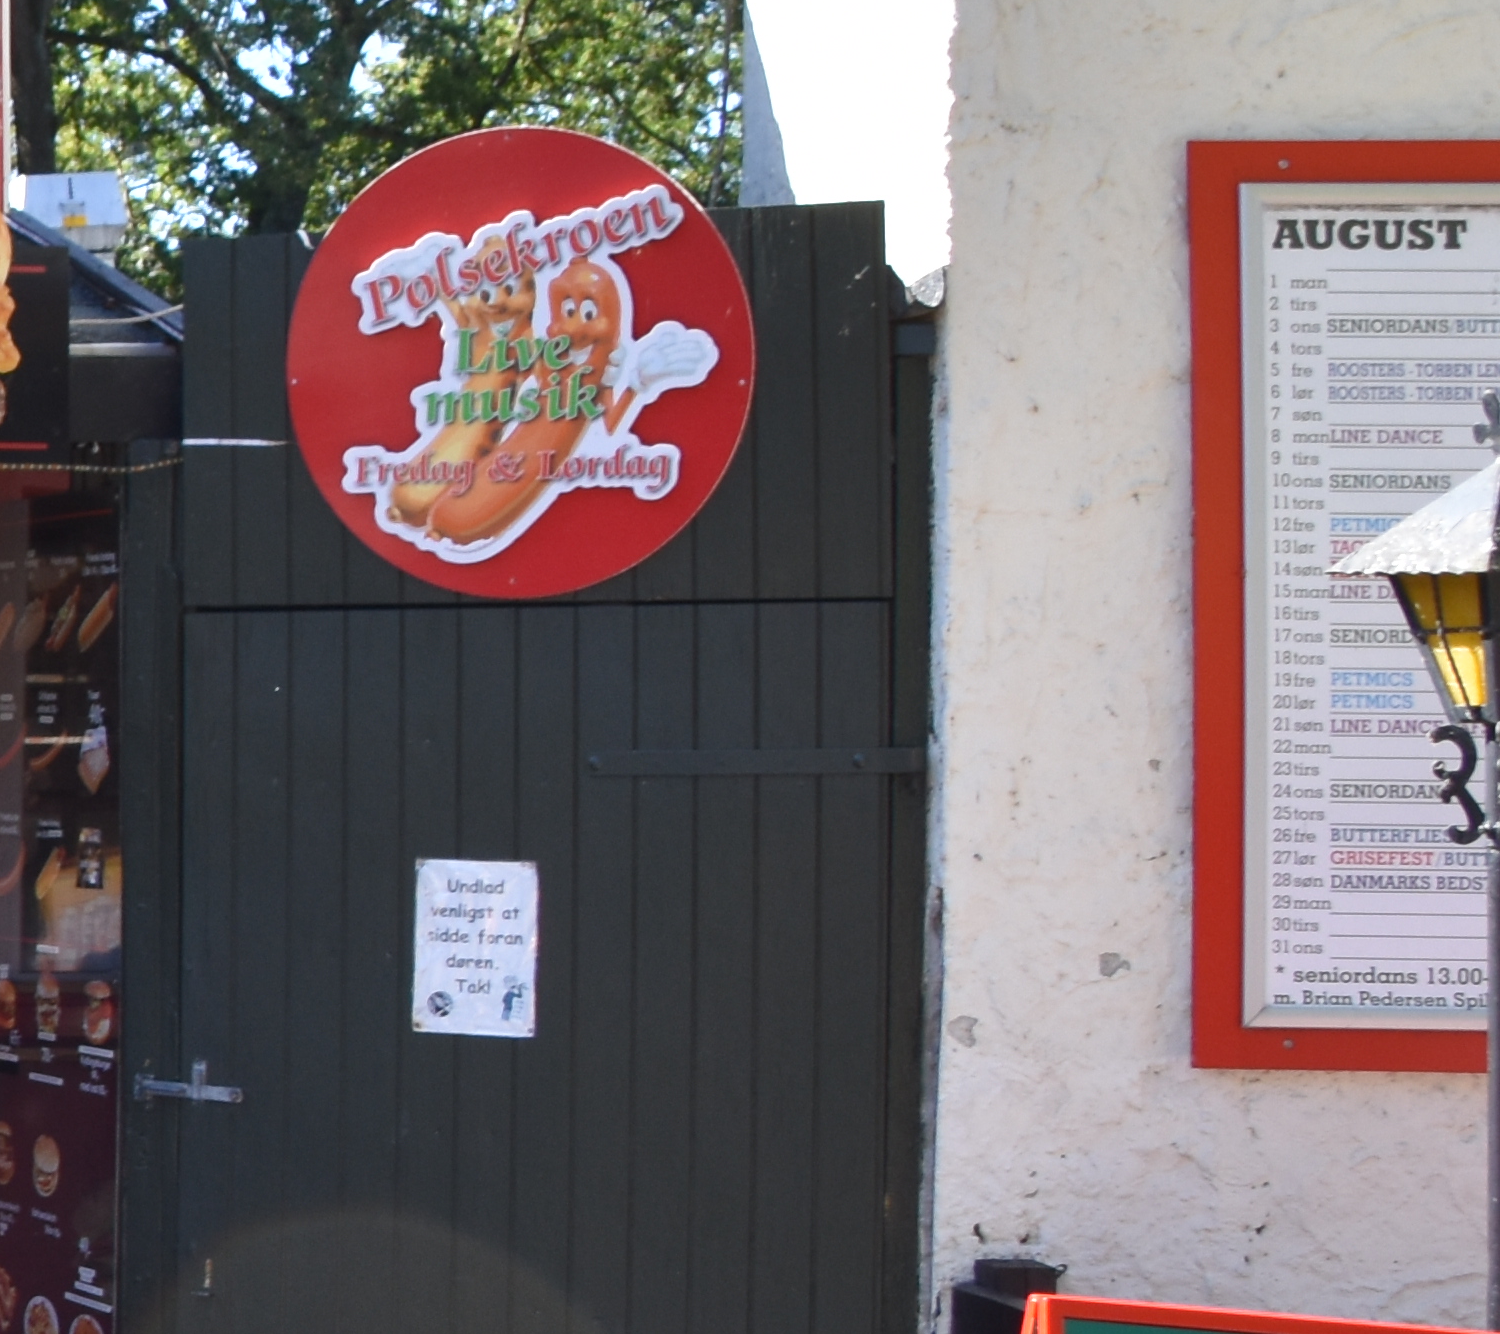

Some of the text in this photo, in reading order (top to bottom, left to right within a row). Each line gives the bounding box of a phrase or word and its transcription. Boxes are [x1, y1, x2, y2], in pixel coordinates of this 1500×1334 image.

[1272, 219, 1468, 250] AUGUST
[364, 194, 672, 327] Pølsekroen
[1269, 274, 1328, 289] 1 man
[1269, 296, 1318, 311] 2 tirs
[1269, 318, 1450, 334] 3 ons SENIORDANS
[453, 327, 573, 375] Live
[1269, 341, 1322, 356] 4 tors
[1270, 362, 1473, 378] 5 fre ROOSTERS TORBEN
[427, 367, 608, 427] musik
[1270, 384, 1280, 399] 6
[1292, 385, 1314, 400] lør
[1328, 386, 1406, 401] ROOSTERS
[1416, 386, 1473, 401] TORBEN
[1271, 406, 1323, 422] 7 søn
[1270, 428, 1281, 443] 8
[1330, 429, 1372, 444] LINE
[1376, 429, 1443, 444] DANCE
[355, 448, 671, 496] Fredag & Lørdag
[1272, 472, 1452, 490] 10 ons SENIORDANS
[1330, 517, 1400, 533] PETMIC
[1330, 629, 1415, 644] SENIORD
[1274, 672, 1414, 688] 19 fre PETMICS
[1330, 694, 1414, 710] PETMICS
[1330, 719, 1372, 734] LINE
[1272, 784, 1442, 800] 24 ons SENIORDAN
[1272, 828, 1292, 843] 26
[1293, 828, 1317, 843] fre
[1272, 850, 1291, 866] 27
[1293, 851, 1317, 866] lør
[447, 879, 505, 895] Undlad
[1272, 873, 1291, 888] 28
[1293, 875, 1324, 889] søn
[1330, 874, 1431, 890] DANMARKS
[431, 903, 520, 923] venligst at
[428, 928, 524, 946] sidde foran
[446, 953, 500, 970] døren.
[1293, 966, 1418, 985] seniordans
[455, 978, 491, 995] Tak!
[1273, 993, 1297, 1007] m.
[1302, 990, 1353, 1007] Brian
[1359, 991, 1448, 1008] Pedersen
